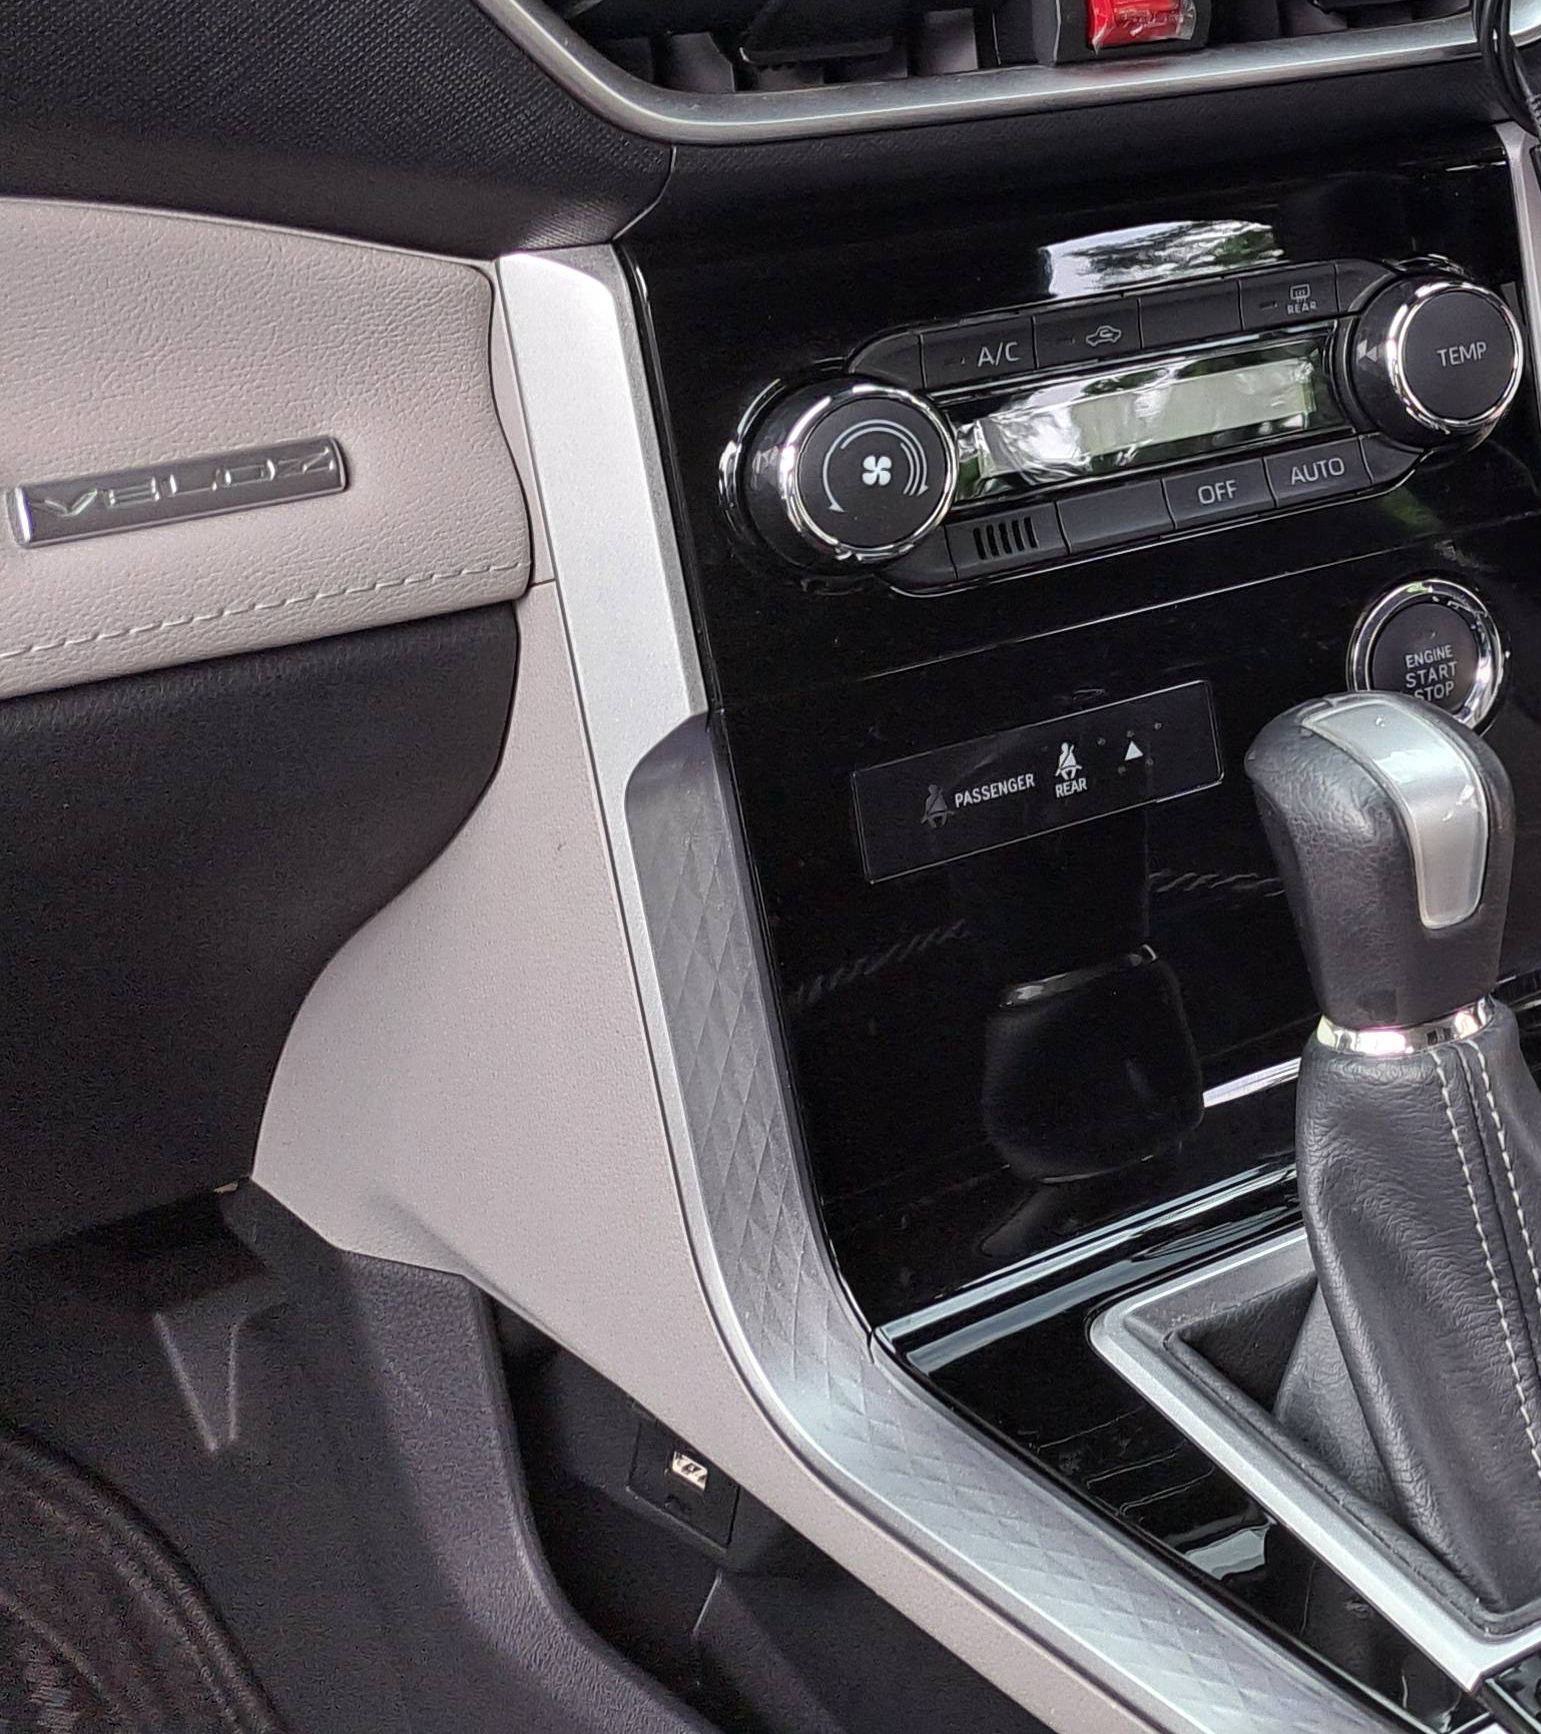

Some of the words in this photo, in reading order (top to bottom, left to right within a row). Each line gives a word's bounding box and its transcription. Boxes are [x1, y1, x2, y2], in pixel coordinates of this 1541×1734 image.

[1287, 301, 1317, 315] REAR
[977, 341, 1021, 367] A/C
[1437, 341, 1488, 367] TEMP
[1290, 457, 1346, 485] AUTO
[1198, 478, 1240, 505] OFF
[1405, 644, 1454, 669] ENGINE
[1405, 660, 1458, 688] START
[955, 773, 1036, 809] PASSENGER
[1055, 777, 1088, 799] REAR
